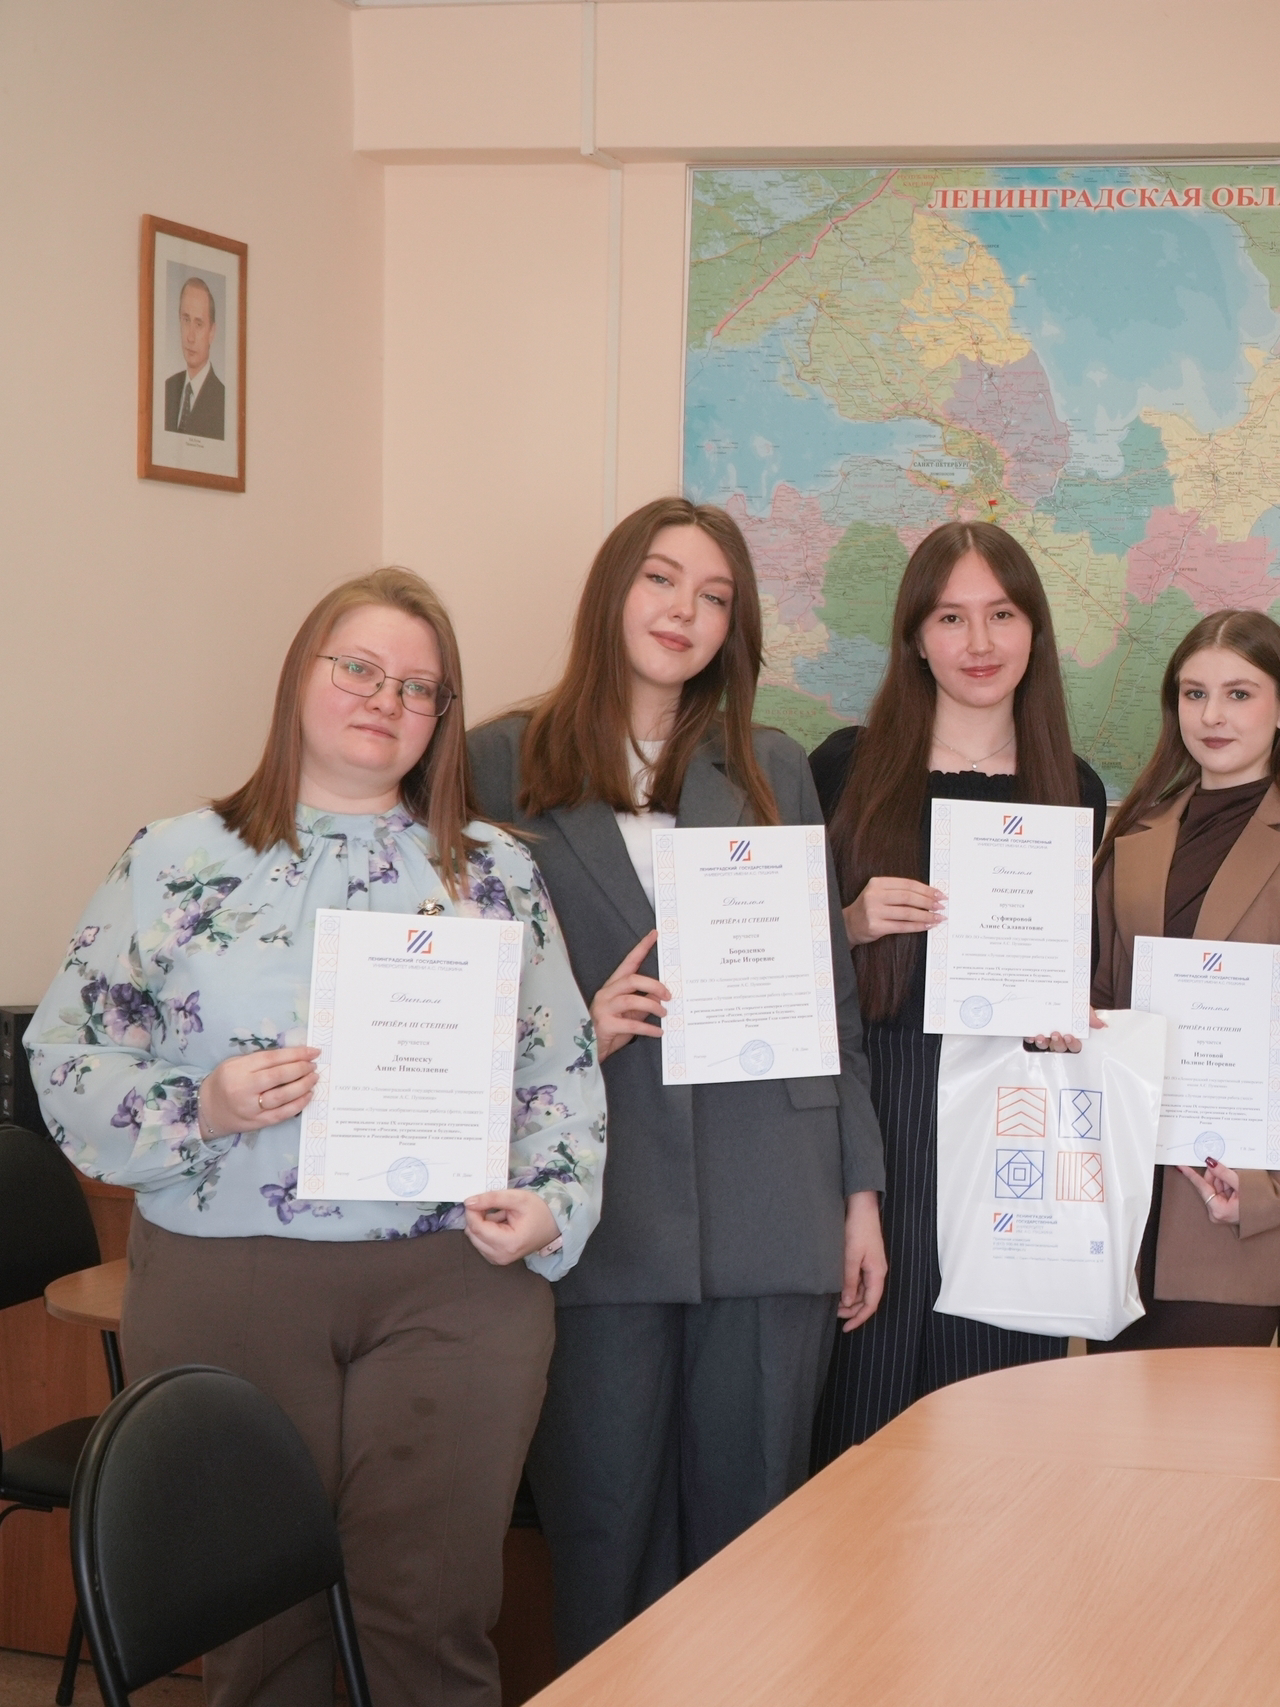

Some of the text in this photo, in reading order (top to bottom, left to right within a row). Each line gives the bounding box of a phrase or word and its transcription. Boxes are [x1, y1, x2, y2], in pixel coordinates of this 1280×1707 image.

[928, 188, 1201, 212] ЛЕНИНГРАДСКАЯ
[748, 916, 780, 924] СТЕПЕНИ
[390, 992, 442, 1004] Диплом
[371, 1020, 408, 1028] ПРИЗЁРА
[420, 1022, 458, 1030] СТЕПЕНИ
[398, 1066, 449, 1074] Николаевне
